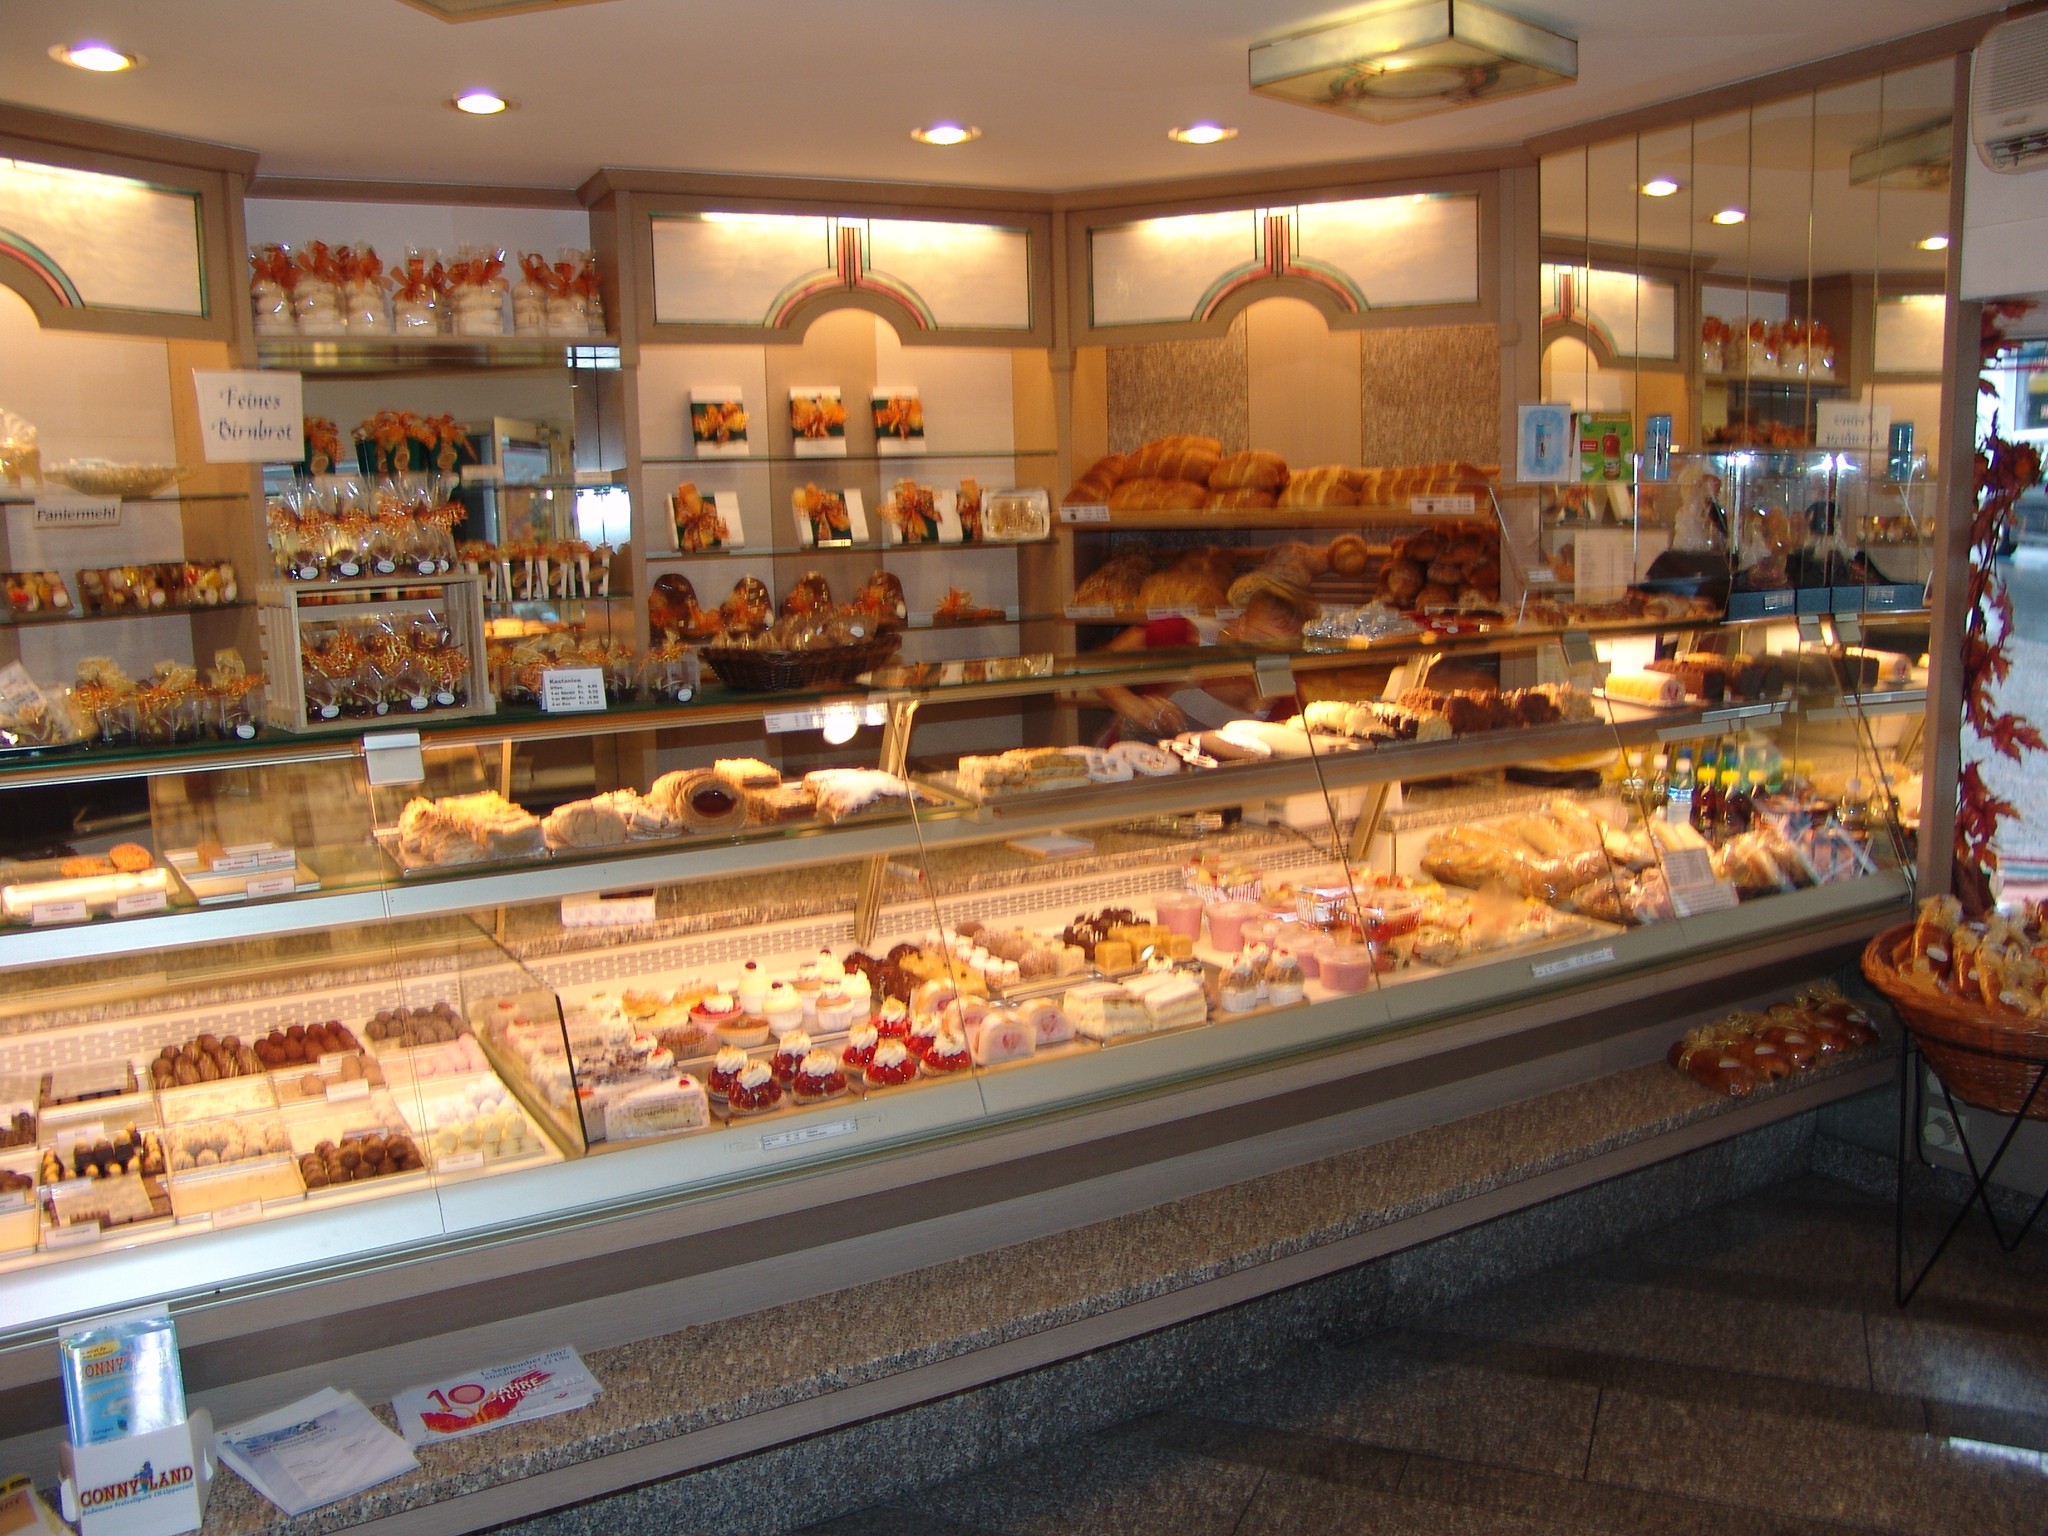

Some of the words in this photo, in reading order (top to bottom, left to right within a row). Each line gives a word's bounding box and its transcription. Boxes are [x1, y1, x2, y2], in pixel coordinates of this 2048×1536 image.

[220, 386, 281, 409] Feines
[211, 417, 293, 441] Birnbrot
[37, 506, 116, 521] Paniermehl
[82, 1355, 125, 1378] ONNY
[489, 1357, 543, 1376] September
[544, 1349, 568, 1361] 2007
[427, 1383, 486, 1412] 10
[490, 1377, 540, 1402] JAHRE
[80, 1478, 138, 1508] CONNY
[149, 1465, 194, 1491] LAND
